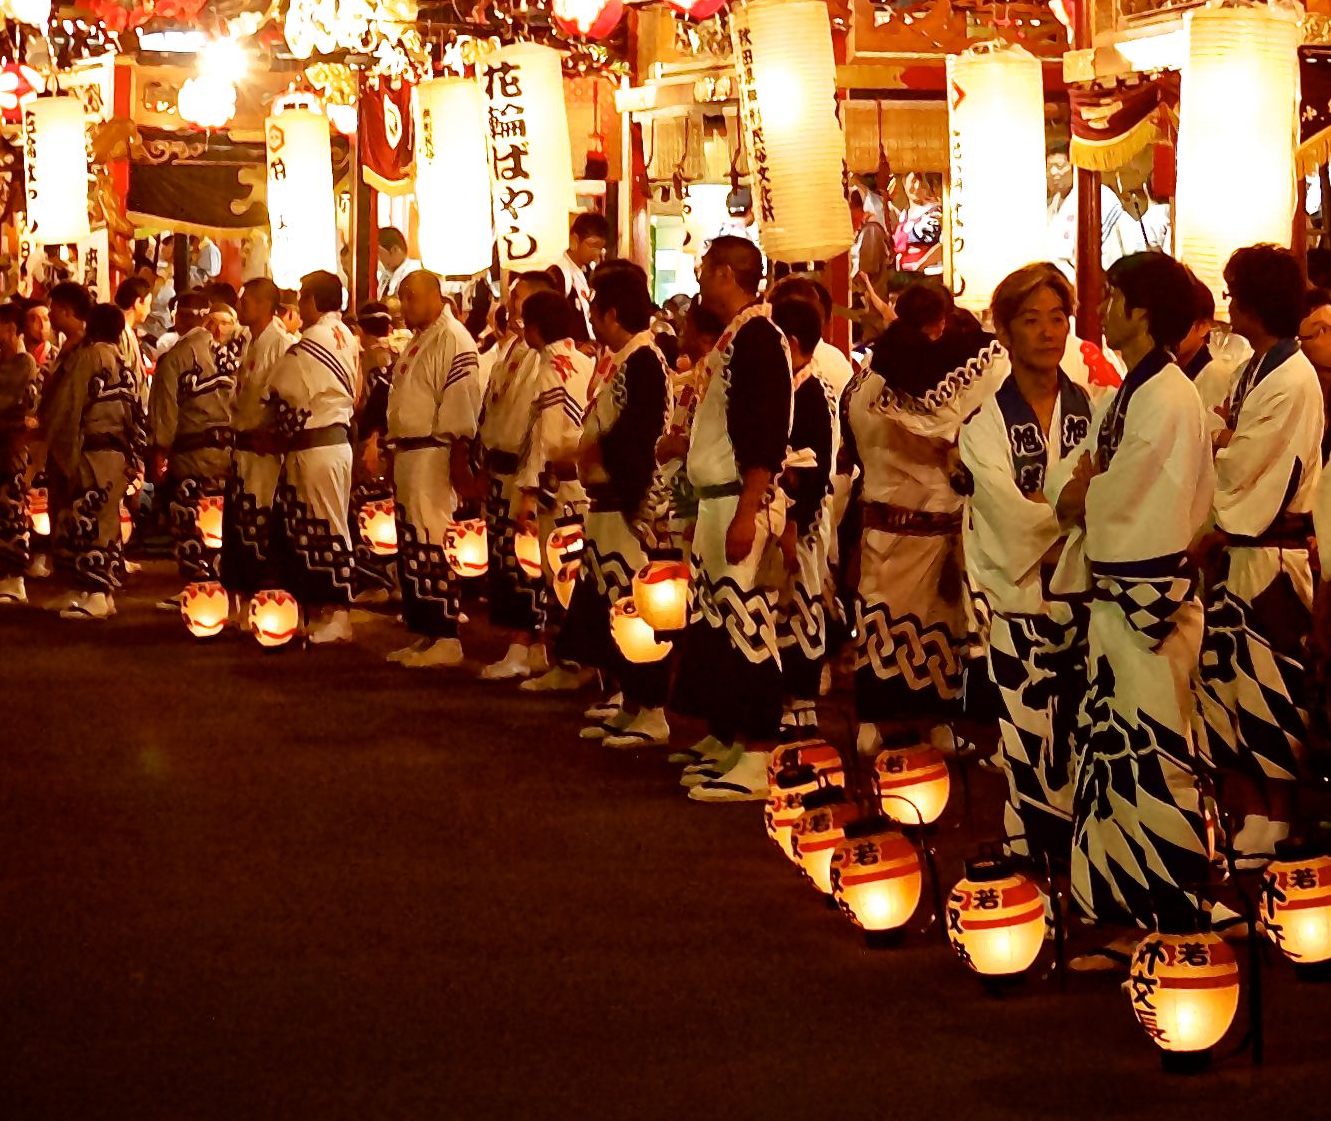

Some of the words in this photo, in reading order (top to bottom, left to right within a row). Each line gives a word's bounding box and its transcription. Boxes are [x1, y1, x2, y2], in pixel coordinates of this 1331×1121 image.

[483, 61, 538, 261] 花輪ばやし
[853, 842, 879, 866] 若
[1290, 867, 1318, 889] 若
[973, 889, 1000, 910] 若
[1177, 941, 1210, 967] 若
